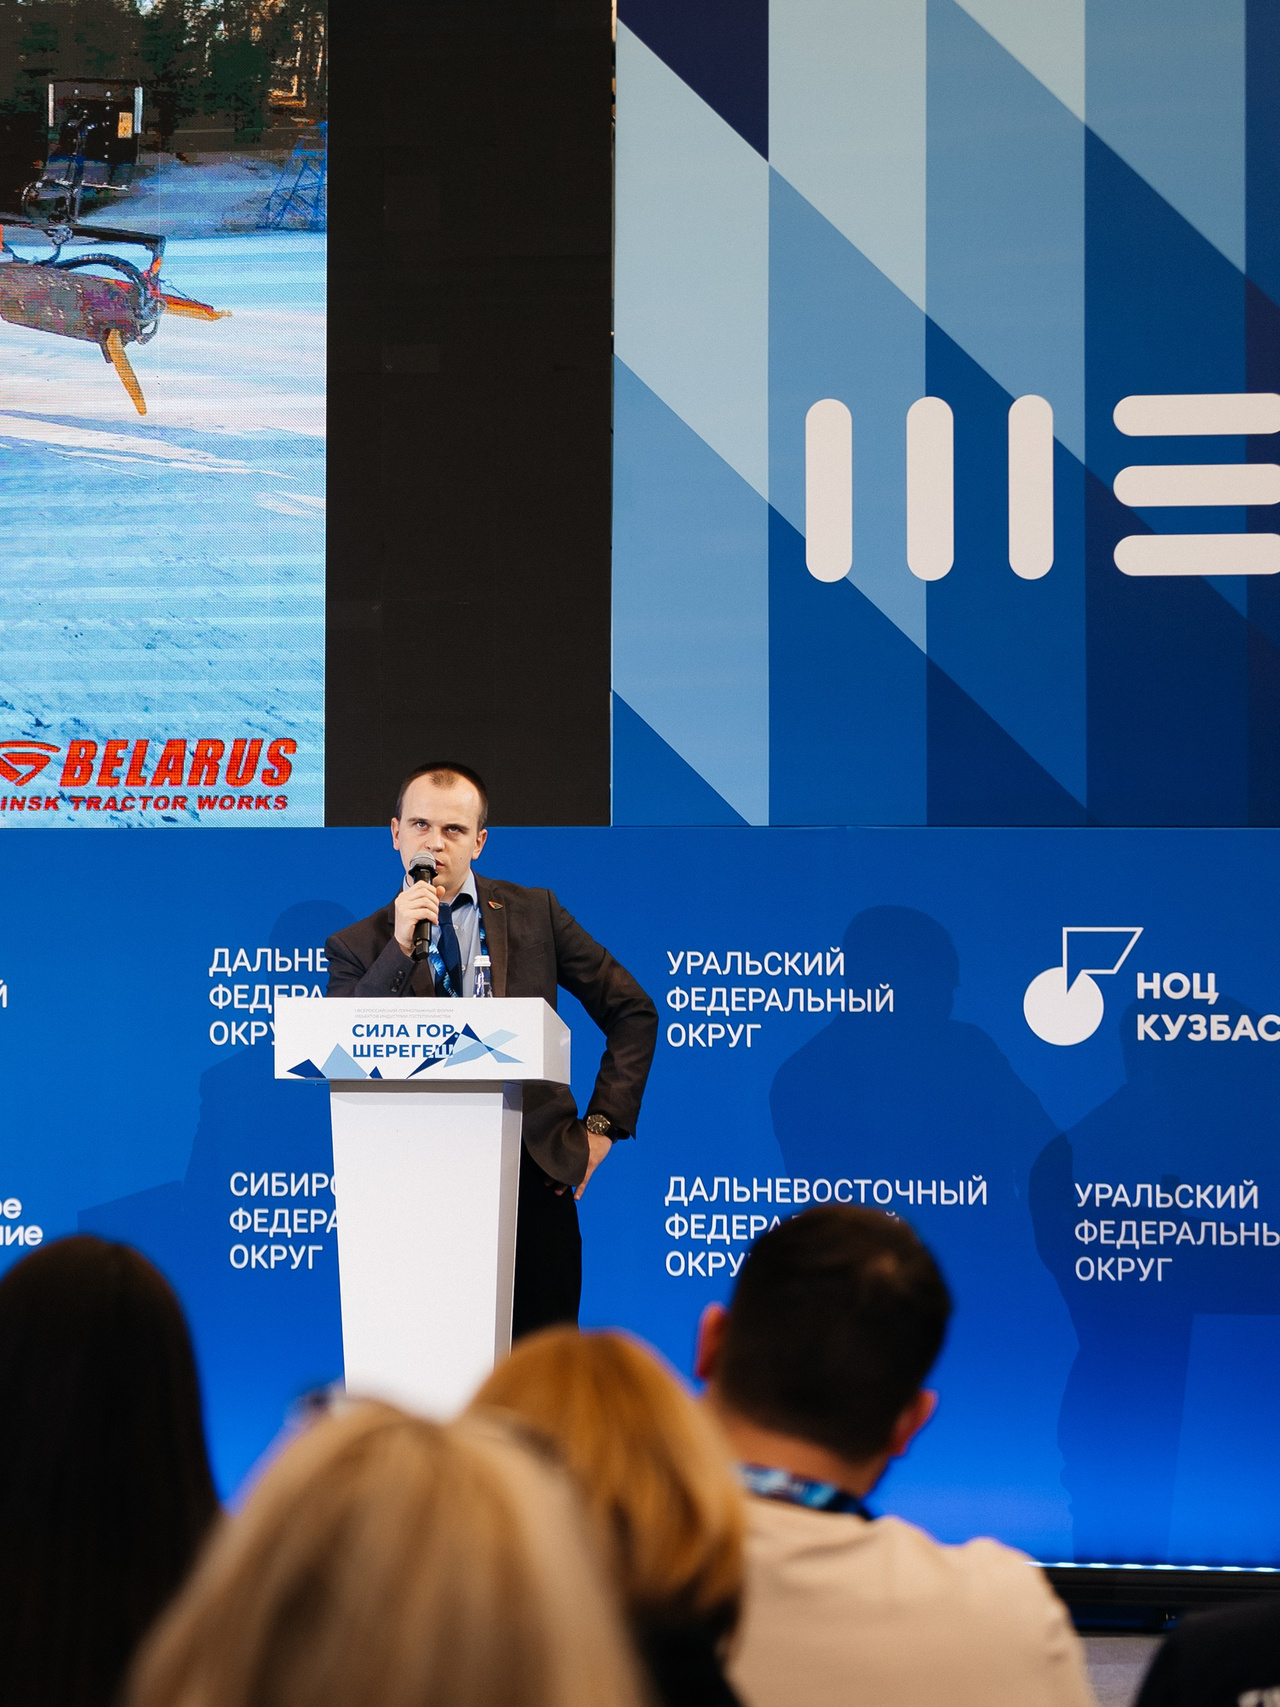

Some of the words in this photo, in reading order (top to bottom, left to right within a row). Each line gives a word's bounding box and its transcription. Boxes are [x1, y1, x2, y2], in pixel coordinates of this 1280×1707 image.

[60, 738, 297, 787] BELARUS
[70, 795, 189, 812] TRACTOR
[197, 794, 289, 811] WORKS
[666, 946, 845, 976] УРАЛЬСКИЙ
[666, 983, 894, 1016] ФЕДЕРАЛЬНЫЙ
[1136, 972, 1220, 1005] НОЦ
[352, 1023, 410, 1038] СИЛА
[416, 1023, 455, 1038] ГОР
[666, 1022, 762, 1048] ОКРУГ
[1136, 1013, 1280, 1042] КУЗБАС
[352, 1044, 454, 1058] ШЕРЕГЕШ
[229, 1171, 336, 1197] СИБИР
[664, 1174, 988, 1206] ДАЛЬНЕВОСТОЧНЫЙ
[1074, 1179, 1258, 1209] УРАЛЬСКИЙ
[229, 1244, 324, 1270] ОКРУГ
[665, 1250, 751, 1278] ОКРУ
[1074, 1256, 1173, 1282] ОКРУГ
